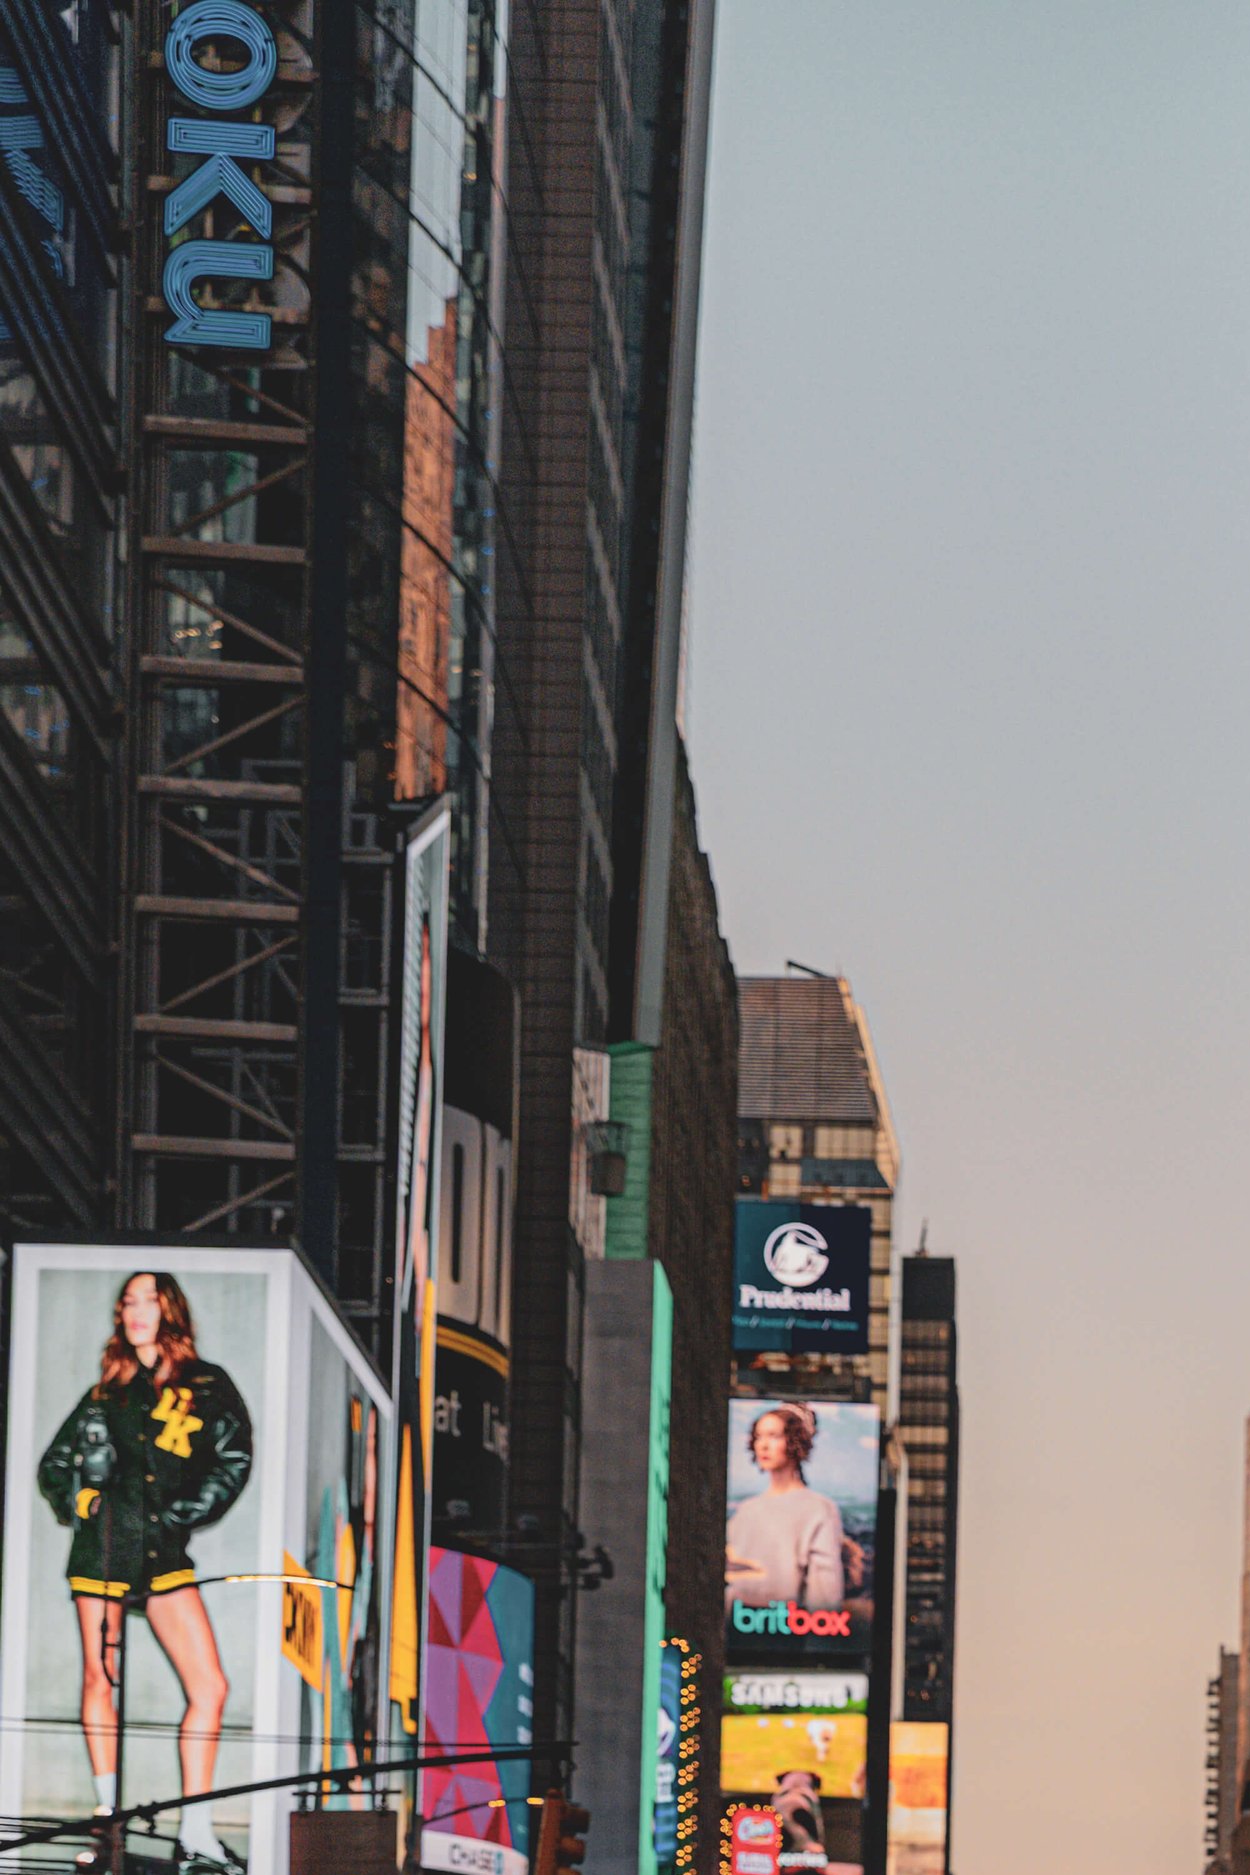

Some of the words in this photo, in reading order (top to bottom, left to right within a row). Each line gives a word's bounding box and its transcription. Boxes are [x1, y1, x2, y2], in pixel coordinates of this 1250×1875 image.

[738, 1283, 852, 1312] Prudential
[733, 1599, 852, 1637] britbox
[730, 1681, 849, 1709] SAMSUNG
